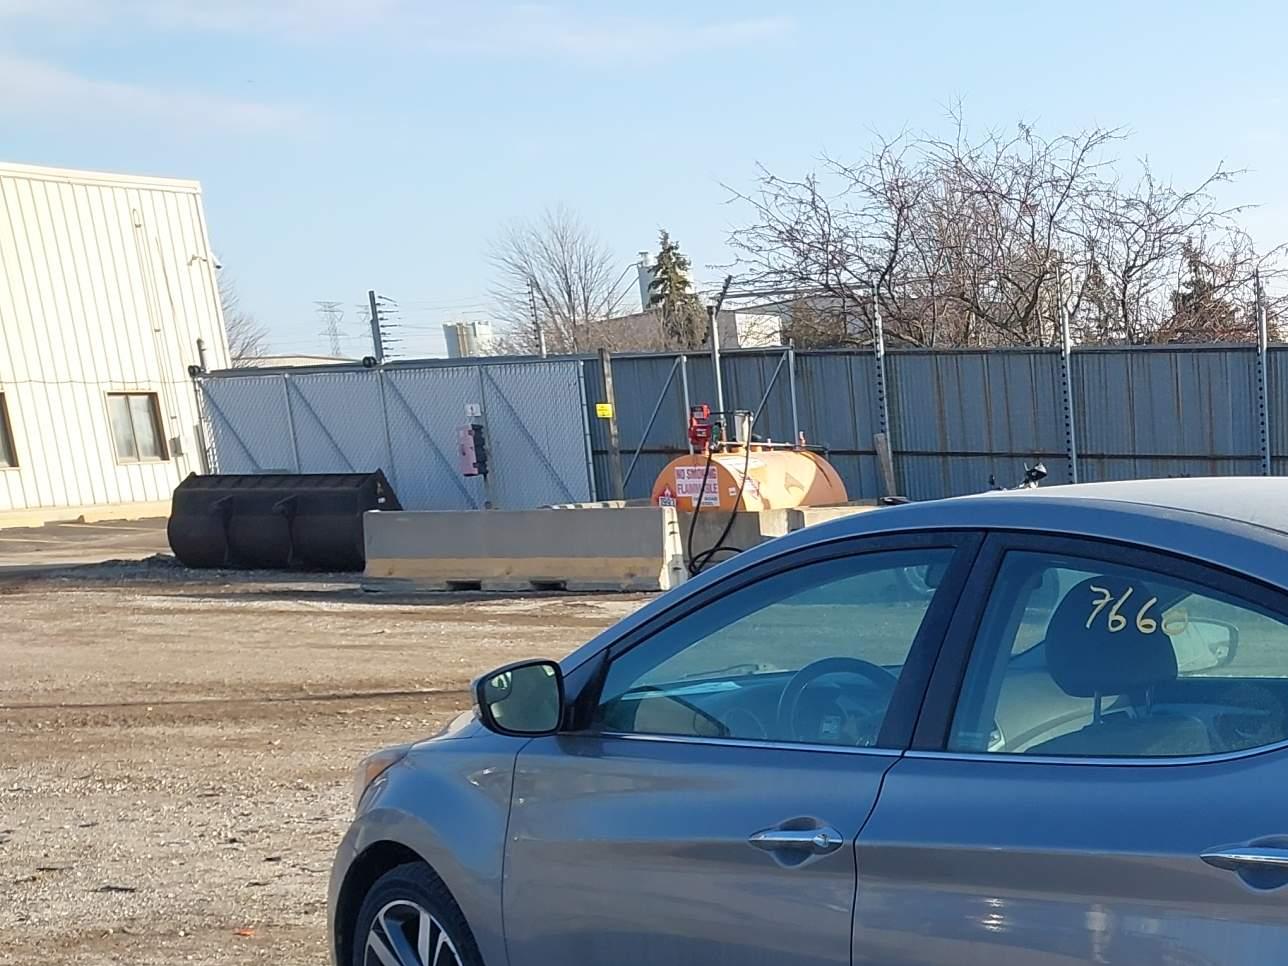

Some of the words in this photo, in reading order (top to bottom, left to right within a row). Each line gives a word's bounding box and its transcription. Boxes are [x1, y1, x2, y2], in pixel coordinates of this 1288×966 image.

[676, 469, 685, 479] NO
[686, 468, 717, 479] SMOKNG
[677, 483, 718, 494] FLAMMBLE
